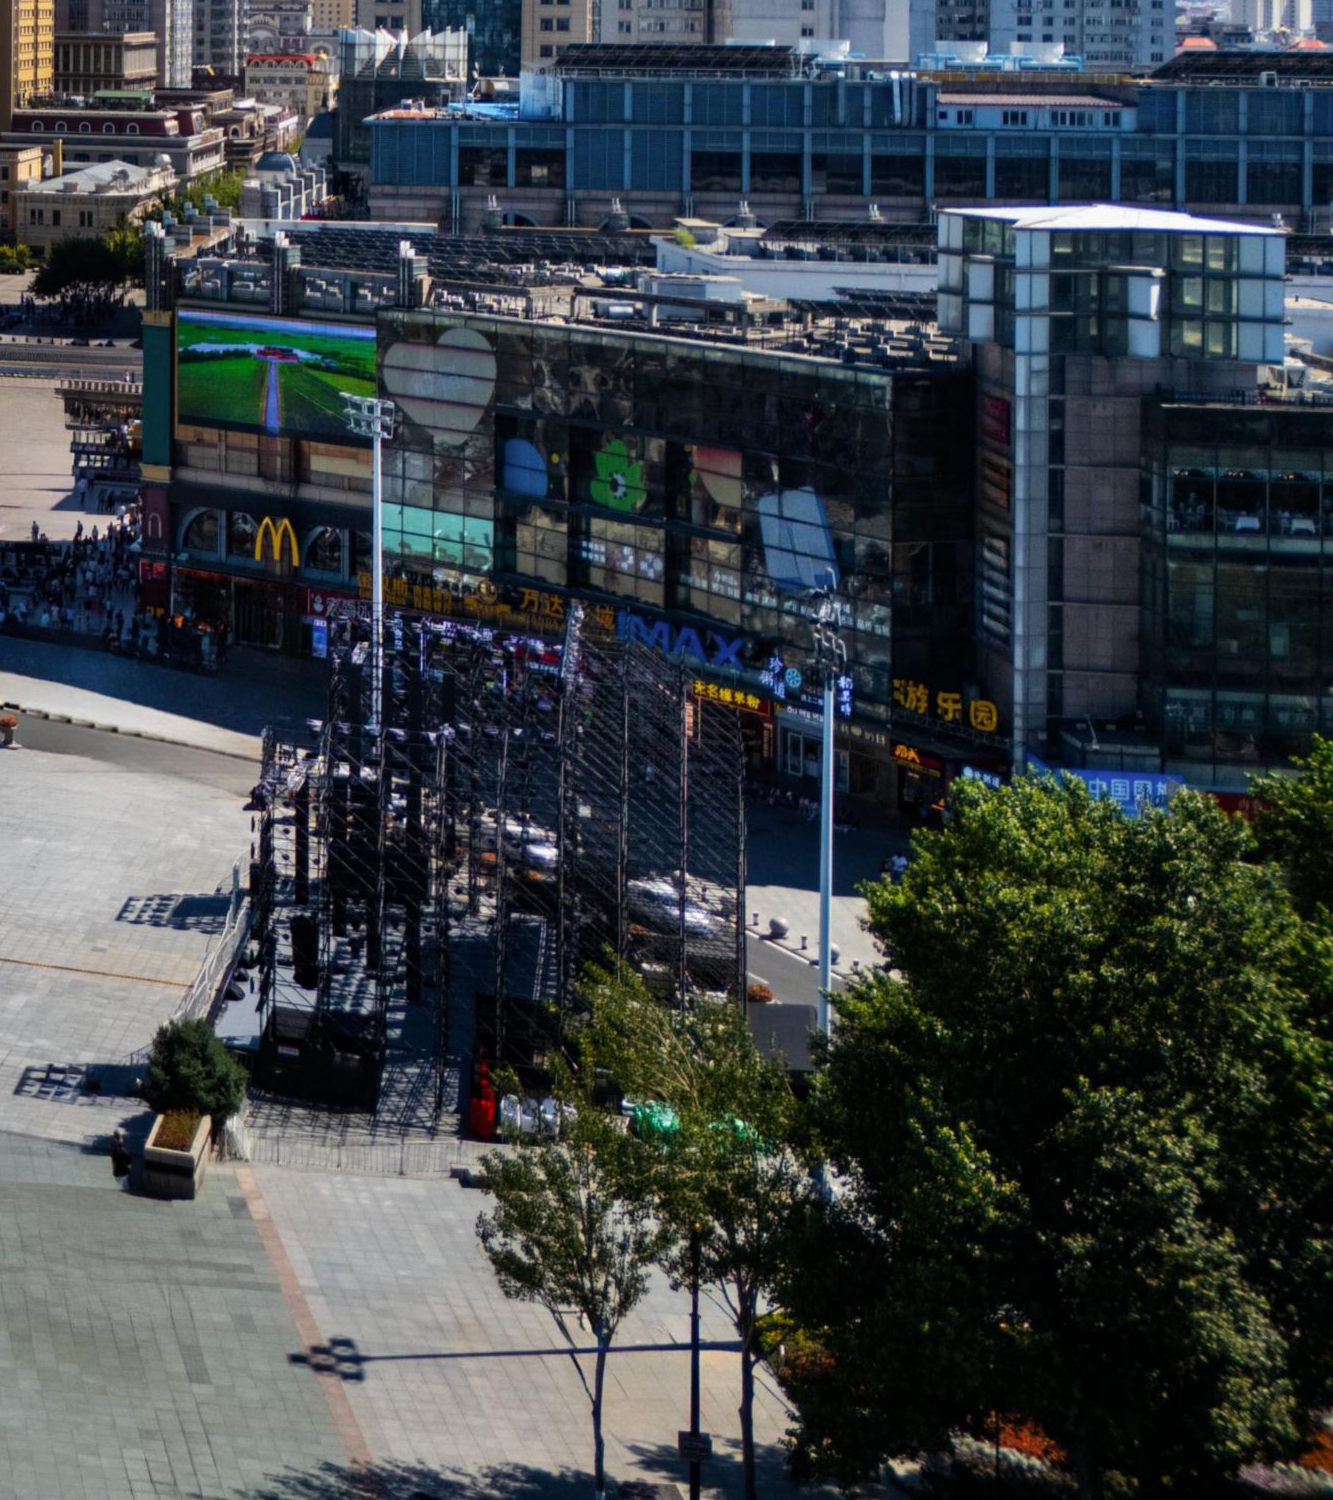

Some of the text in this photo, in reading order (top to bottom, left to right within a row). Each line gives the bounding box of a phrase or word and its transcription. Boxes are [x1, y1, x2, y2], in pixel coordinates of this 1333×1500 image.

[616, 608, 745, 671] IMAX
[900, 679, 999, 732] 游乐园
